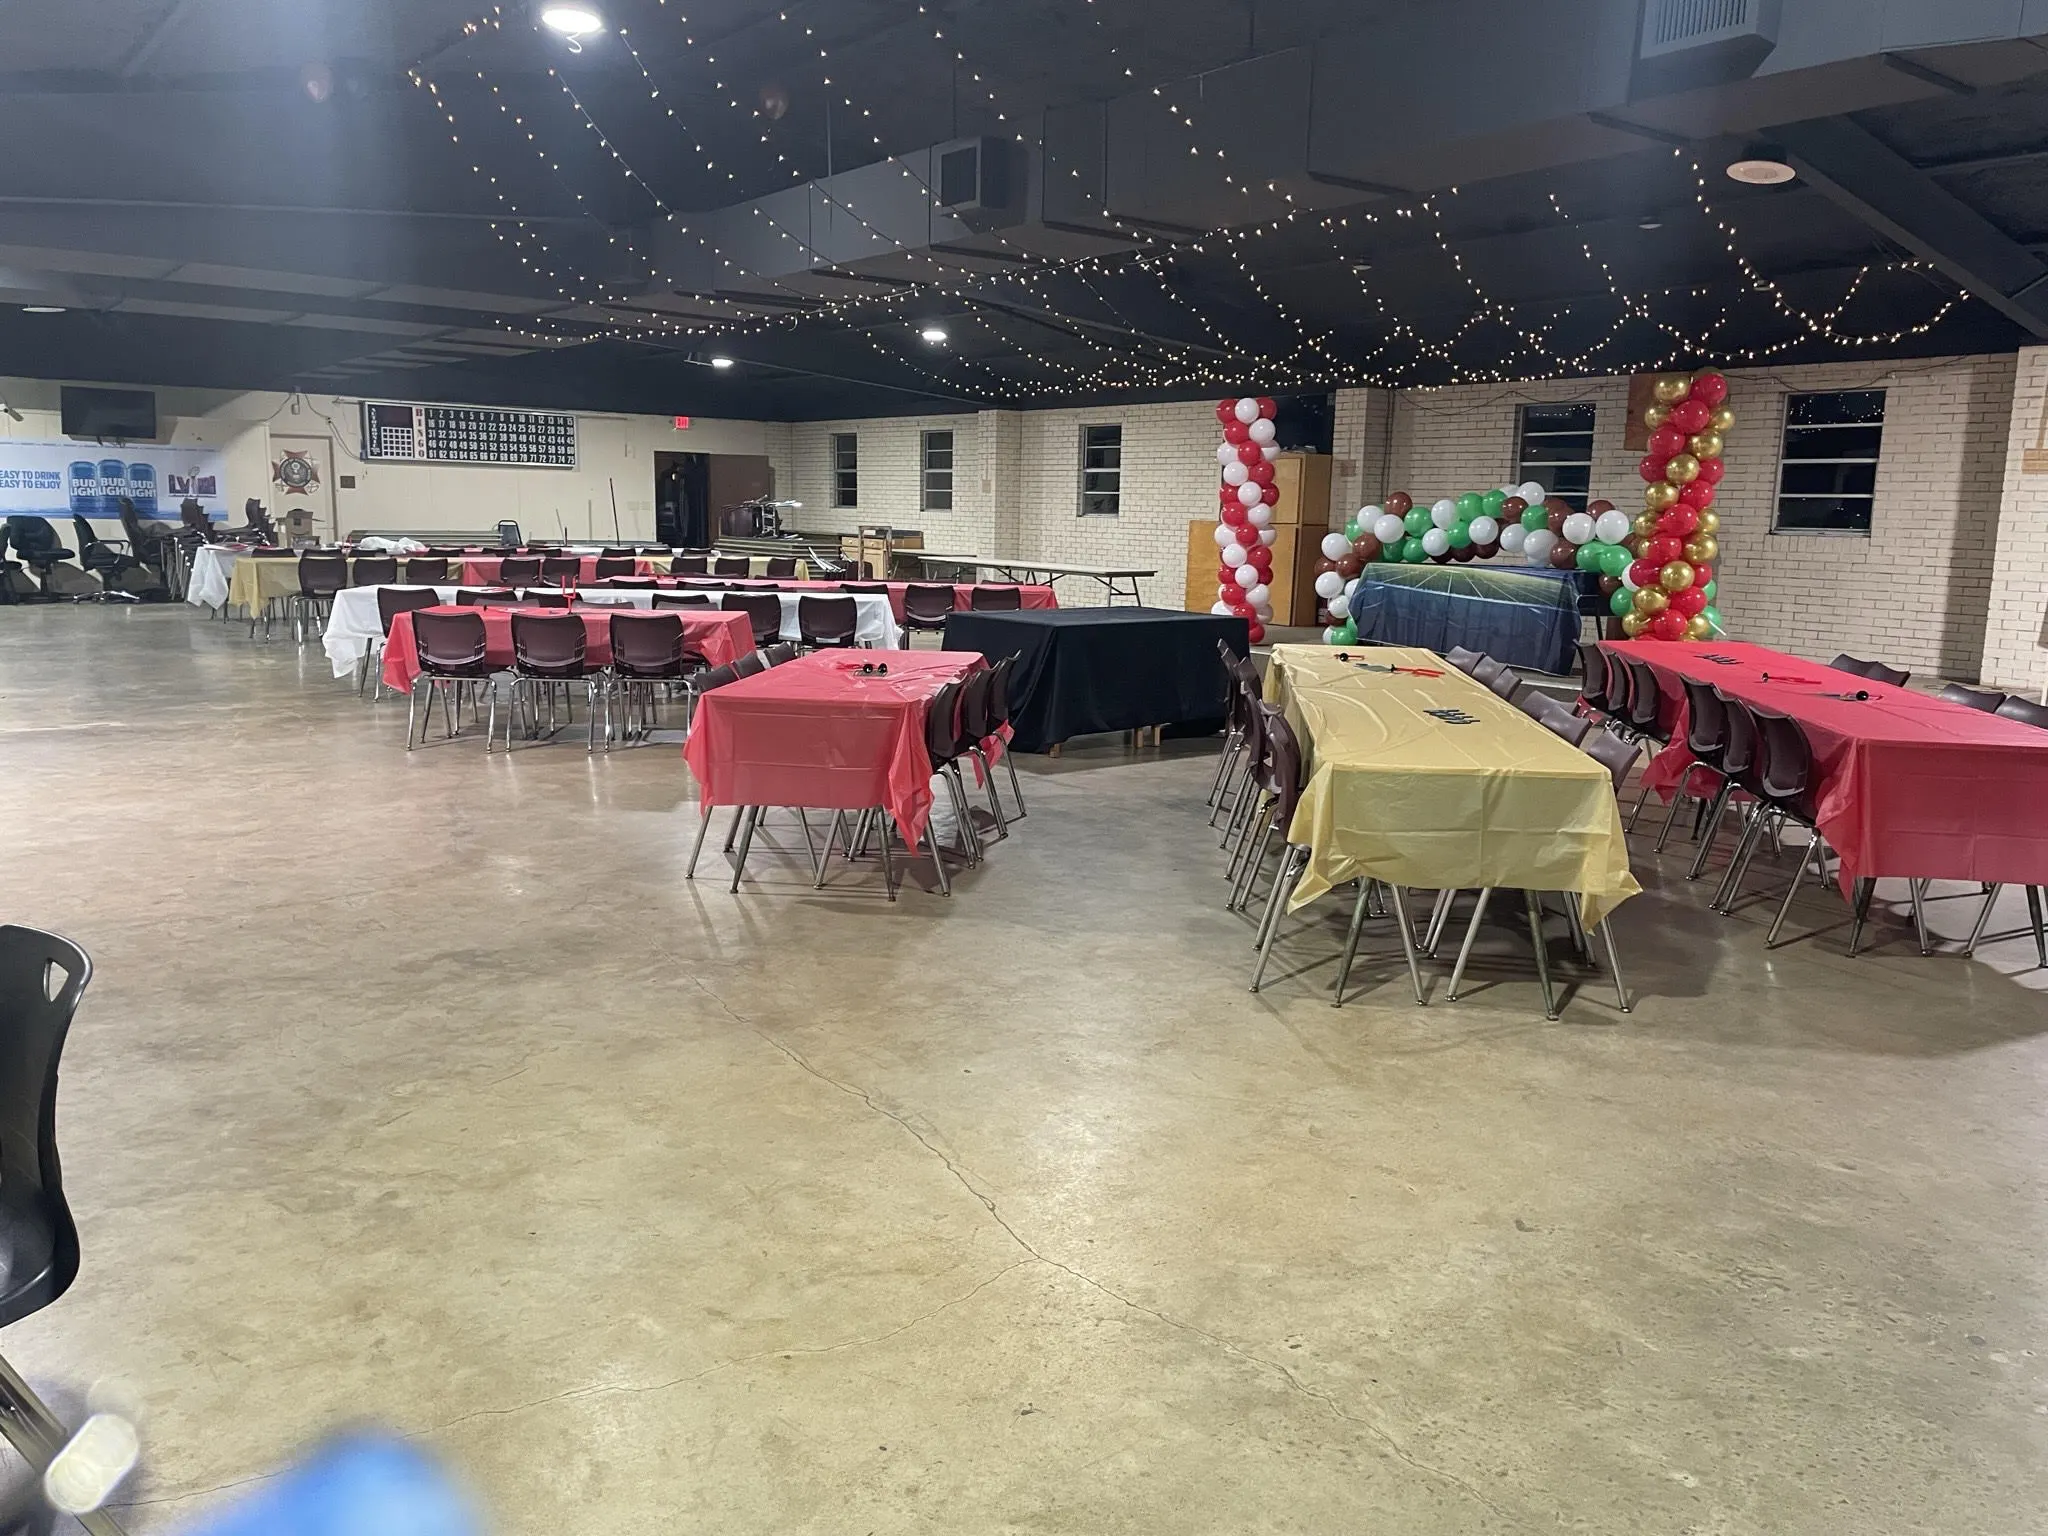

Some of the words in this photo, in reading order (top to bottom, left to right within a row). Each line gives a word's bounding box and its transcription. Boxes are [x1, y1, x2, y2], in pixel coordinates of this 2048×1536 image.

[529, 415, 534, 423] 11
[538, 416, 544, 424] 12
[557, 417, 563, 425] 14
[438, 420, 445, 428] 17
[479, 422, 486, 431] 21
[488, 423, 496, 431] 22
[499, 423, 507, 431] 23
[508, 424, 516, 432] 24
[518, 424, 526, 432] 25
[538, 425, 545, 433] 27
[415, 408, 425, 457] BINGO
[428, 429, 436, 438] 31
[438, 430, 446, 438] 32
[449, 430, 457, 439] 33
[459, 431, 467, 439] 34
[469, 431, 477, 440] 35
[489, 433, 497, 441] 37
[529, 435, 536, 443] 41
[538, 435, 546, 443] 42
[548, 436, 555, 444] 43
[557, 436, 565, 444] 44
[567, 436, 574, 444] 45
[439, 440, 447, 448] 47
[459, 441, 467, 449] 49
[480, 442, 487, 450] 51
[490, 442, 497, 451] 52
[500, 443, 507, 451] 53
[509, 443, 517, 451] 54
[519, 444, 527, 452] 55
[529, 444, 536, 452] 56
[539, 445, 546, 453] 57
[429, 450, 436, 458] 61
[439, 450, 447, 458] 62
[449, 451, 458, 459] 63
[459, 451, 467, 459] 64
[470, 452, 478, 460] 65
[490, 452, 498, 460] 67
[530, 454, 536, 462] 71
[549, 455, 556, 463] 73
[568, 456, 574, 464] 75
[0, 470, 20, 478] EASY
[22, 471, 33, 479] TO
[35, 471, 60, 480] DRINK
[0, 480, 20, 488] EASY
[22, 480, 33, 488] TO
[35, 481, 61, 489] ENJOY
[72, 479, 96, 487] BUD
[101, 478, 125, 486] BUD
[131, 480, 153, 489] BUD
